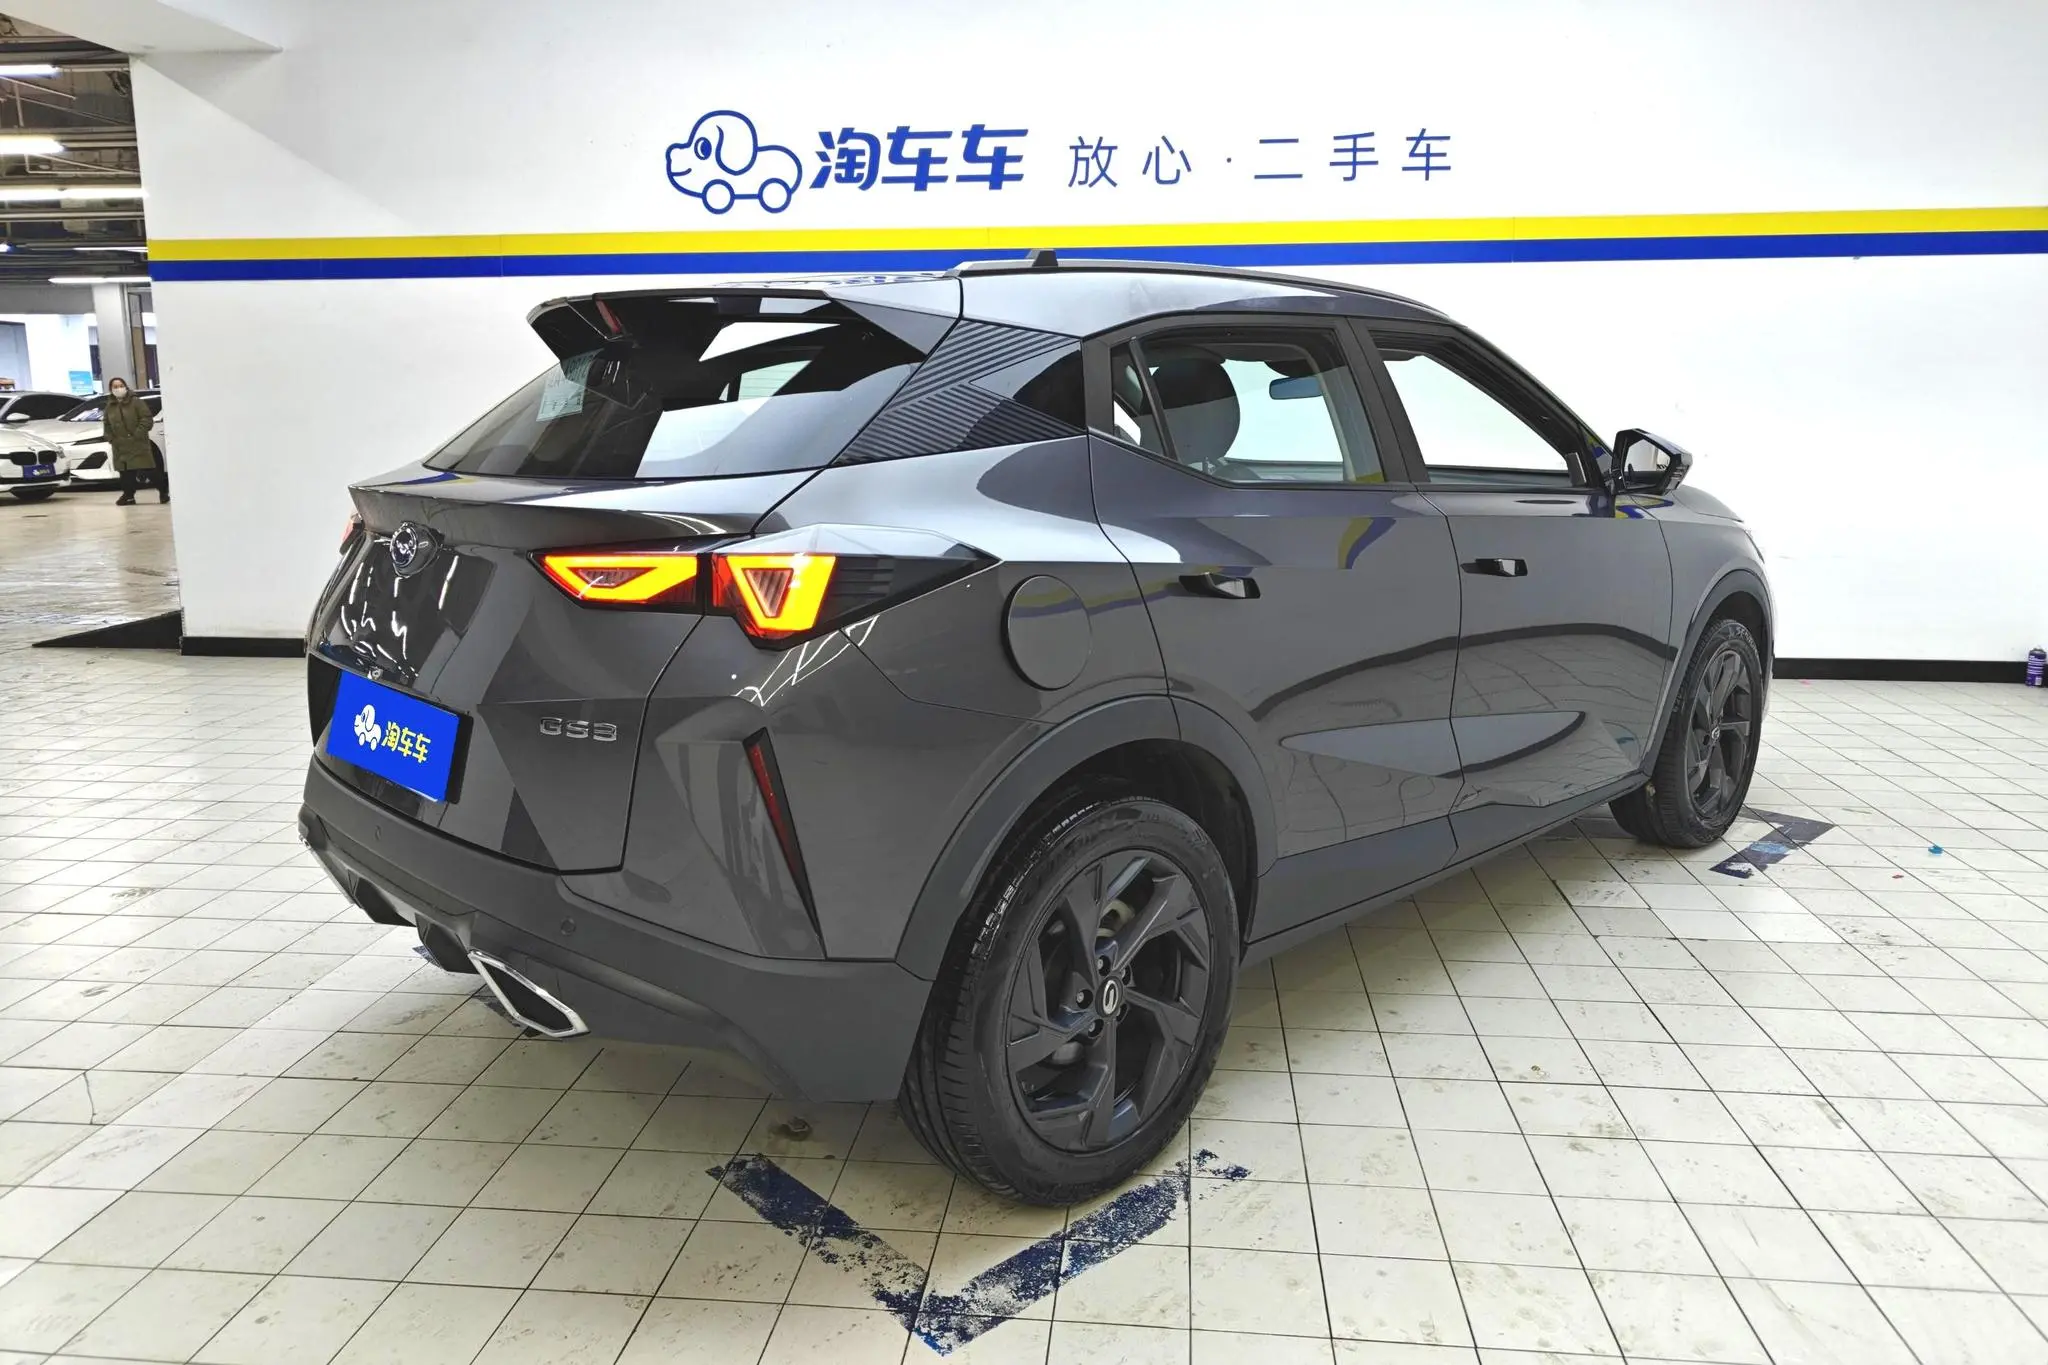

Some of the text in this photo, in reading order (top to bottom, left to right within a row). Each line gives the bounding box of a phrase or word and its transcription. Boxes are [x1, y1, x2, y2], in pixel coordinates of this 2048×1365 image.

[809, 123, 1029, 192] 淘车车
[381, 720, 432, 764] 淘车车
[540, 716, 618, 742] GS3
